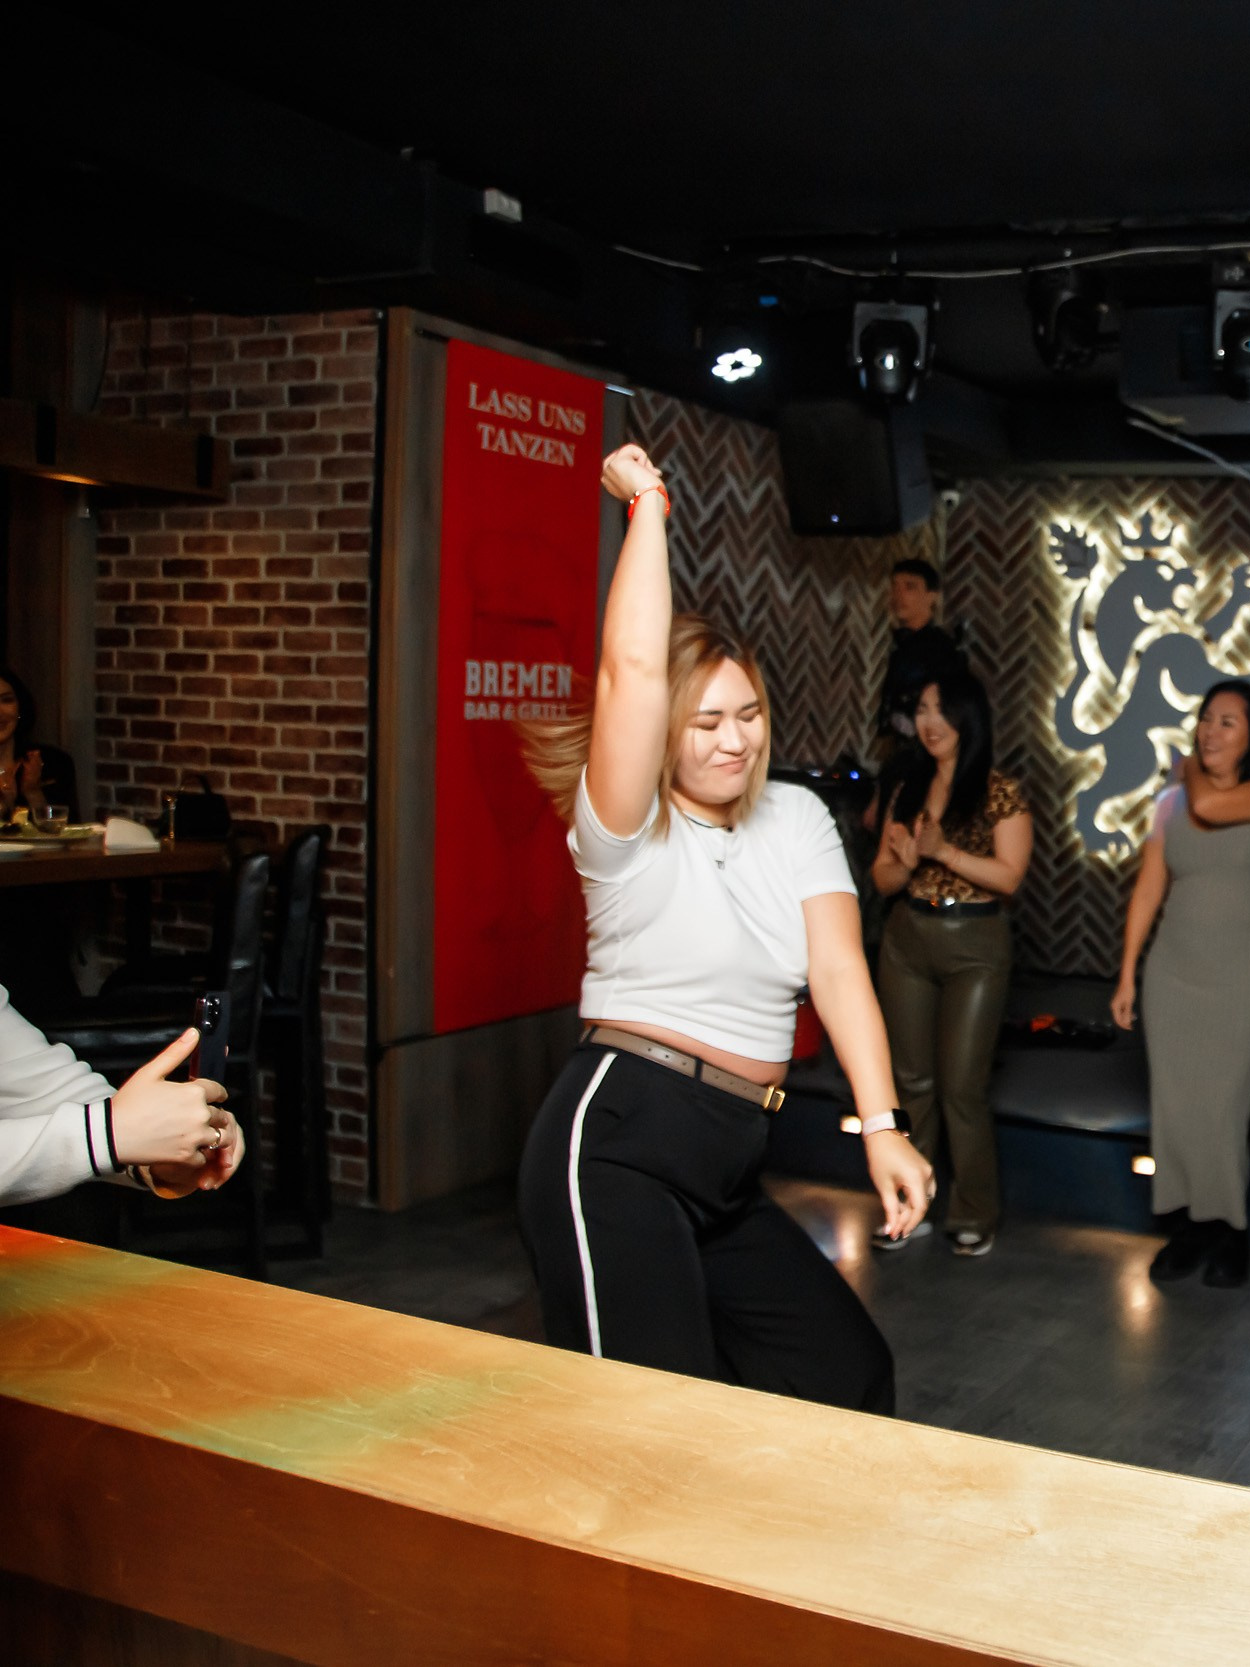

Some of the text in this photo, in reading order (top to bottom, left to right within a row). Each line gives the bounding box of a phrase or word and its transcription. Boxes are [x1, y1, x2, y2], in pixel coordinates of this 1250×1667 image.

[468, 381, 586, 436] LASS UNS
[476, 421, 576, 468] TANZEN
[464, 659, 573, 698] BREMEN
[463, 700, 501, 721] BAR
